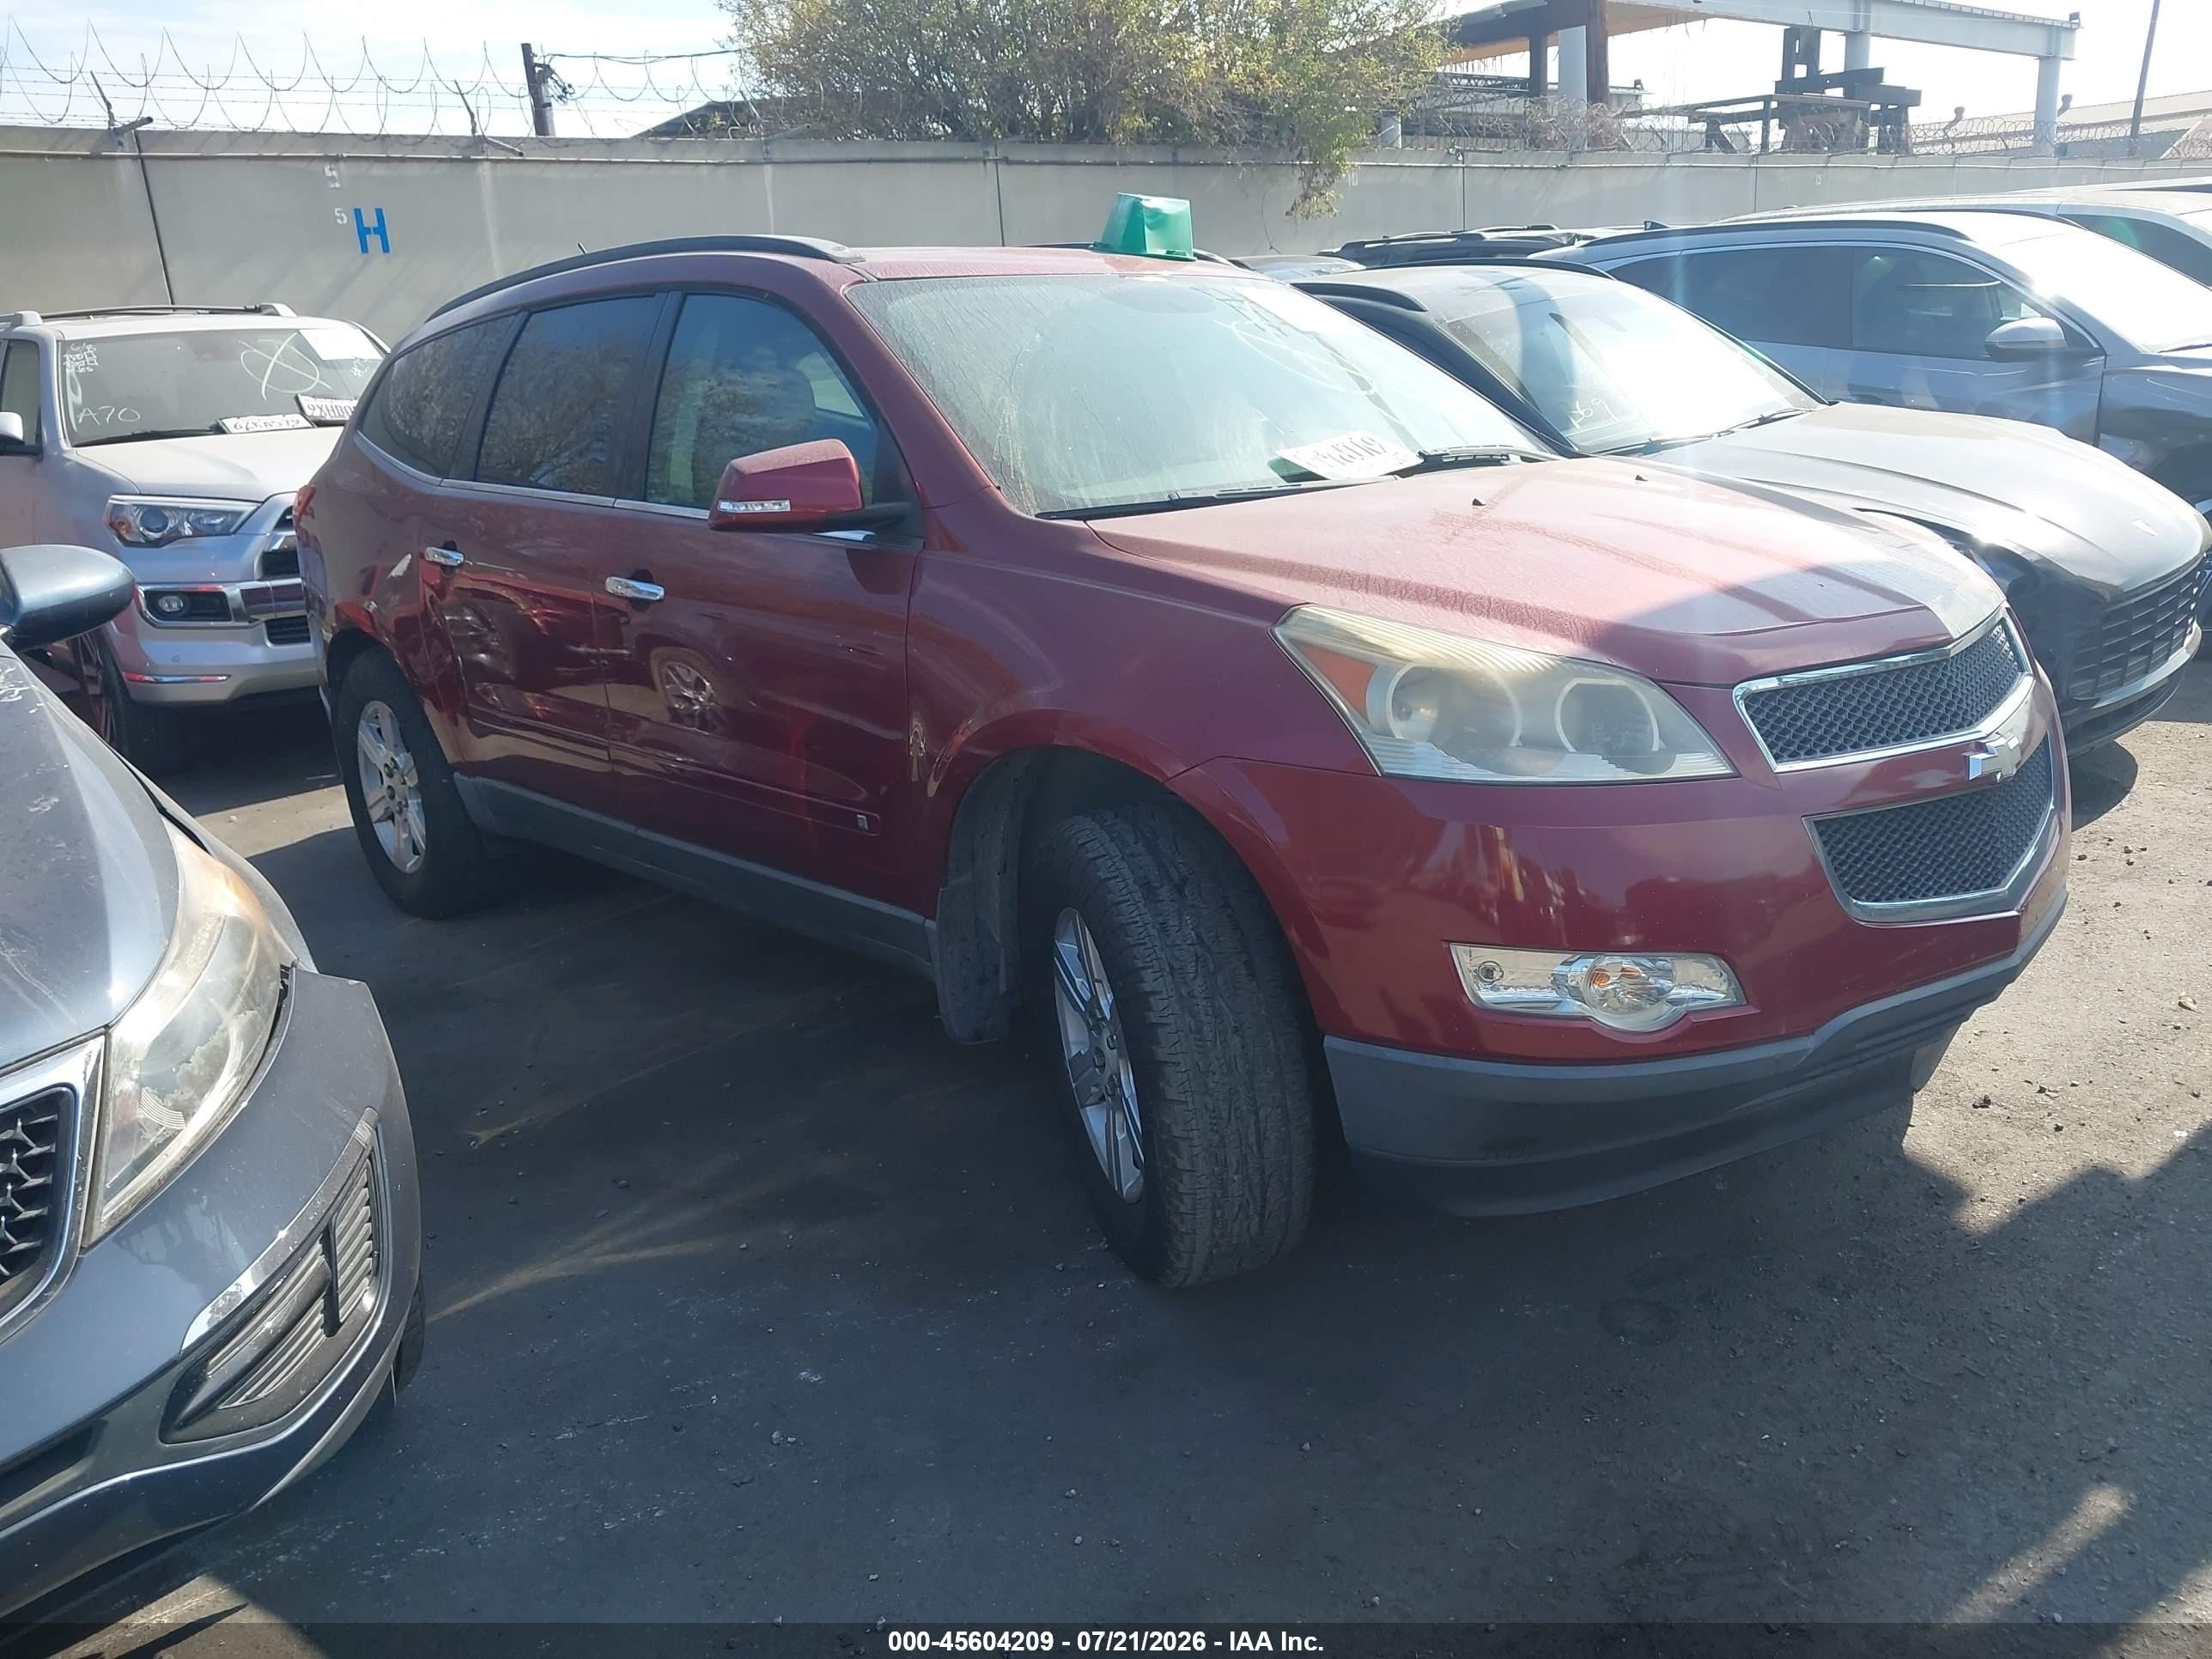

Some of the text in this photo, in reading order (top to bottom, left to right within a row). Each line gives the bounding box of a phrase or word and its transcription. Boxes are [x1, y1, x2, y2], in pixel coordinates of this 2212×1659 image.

[334, 207, 348, 225] 5
[353, 207, 392, 255] H
[76, 405, 141, 426] A70
